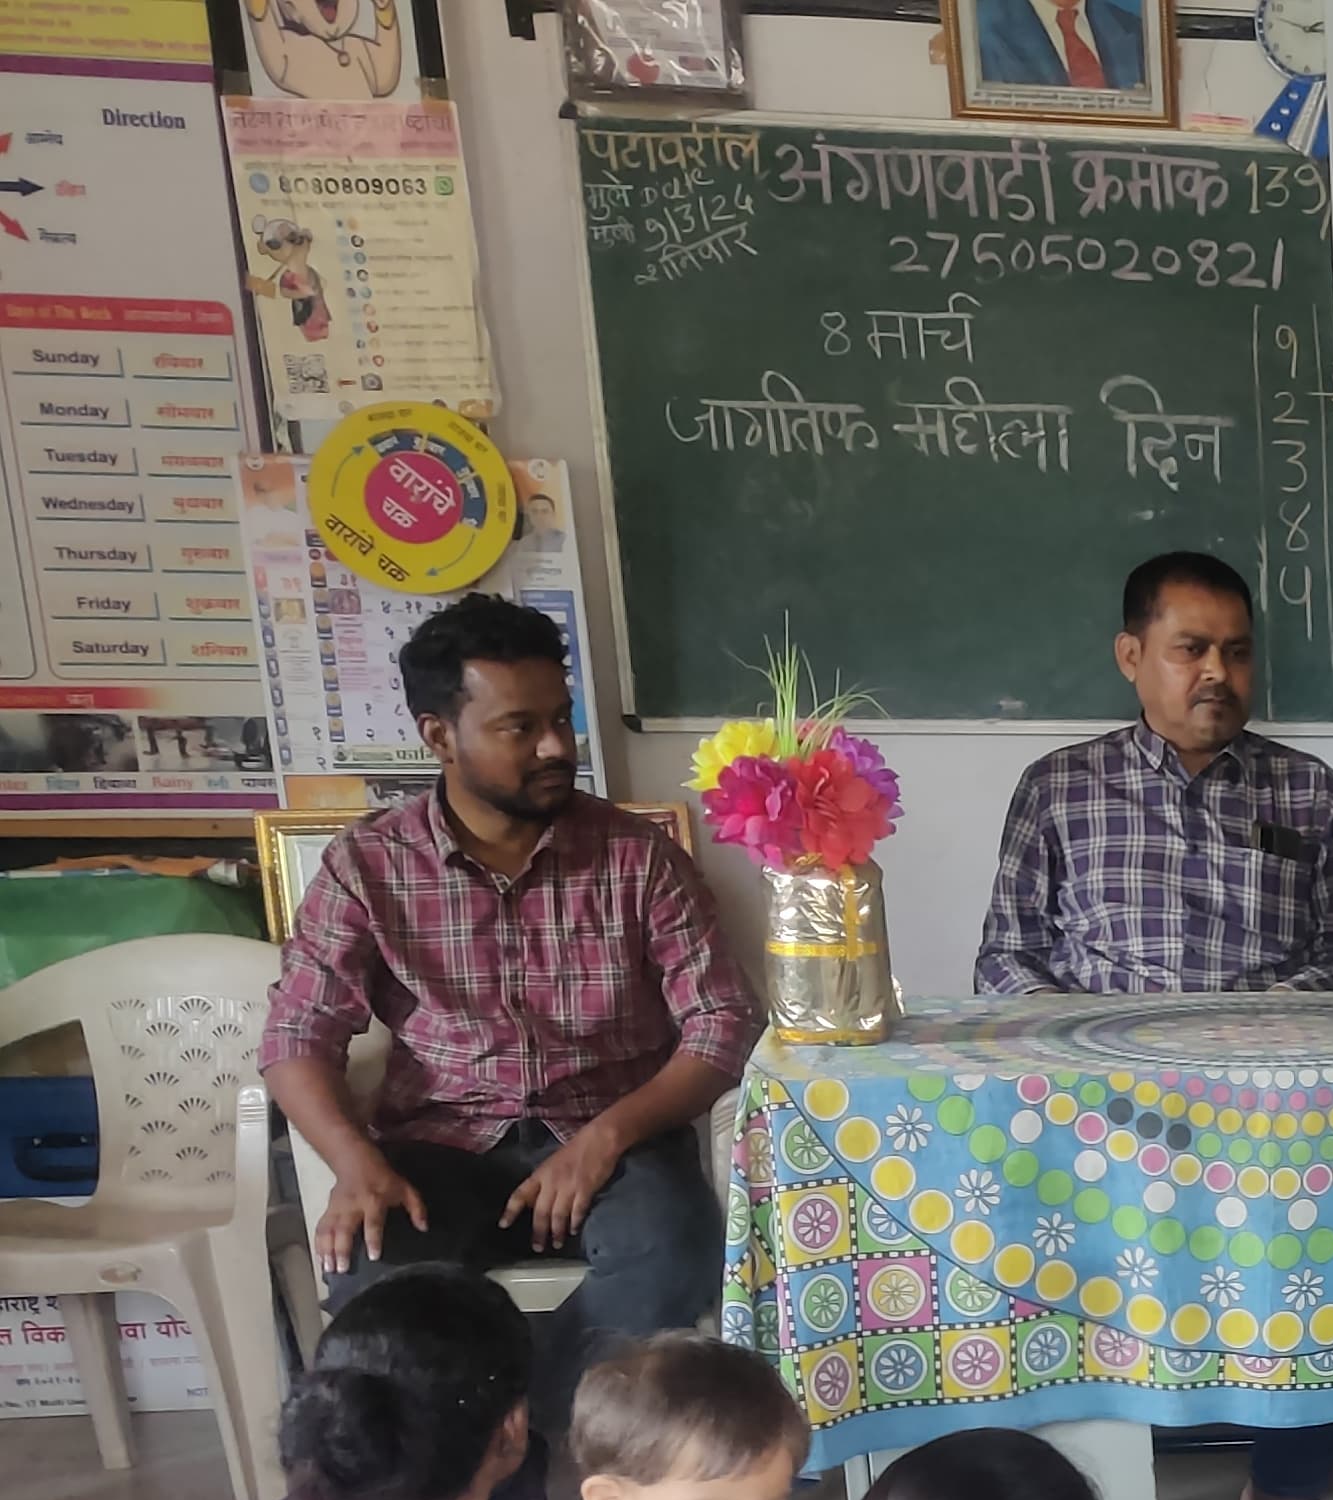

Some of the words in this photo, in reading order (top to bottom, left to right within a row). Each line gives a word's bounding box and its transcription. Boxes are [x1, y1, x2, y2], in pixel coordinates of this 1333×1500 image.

[102, 108, 187, 130] Direction
[888, 232, 1285, 290] 27505020821
[820, 311, 850, 356] 8
[865, 292, 982, 363] मार्च
[32, 349, 100, 367] Sunday
[39, 402, 110, 419] Monday
[1100, 375, 1237, 491] दिन
[43, 448, 118, 466] Tuesday
[41, 496, 135, 514] Wednesday
[382, 496, 418, 529] चक्र
[54, 546, 138, 564] Thursday
[76, 596, 131, 612] Friday
[72, 640, 150, 657] Saturday
[22, 1321, 67, 1345] विक
